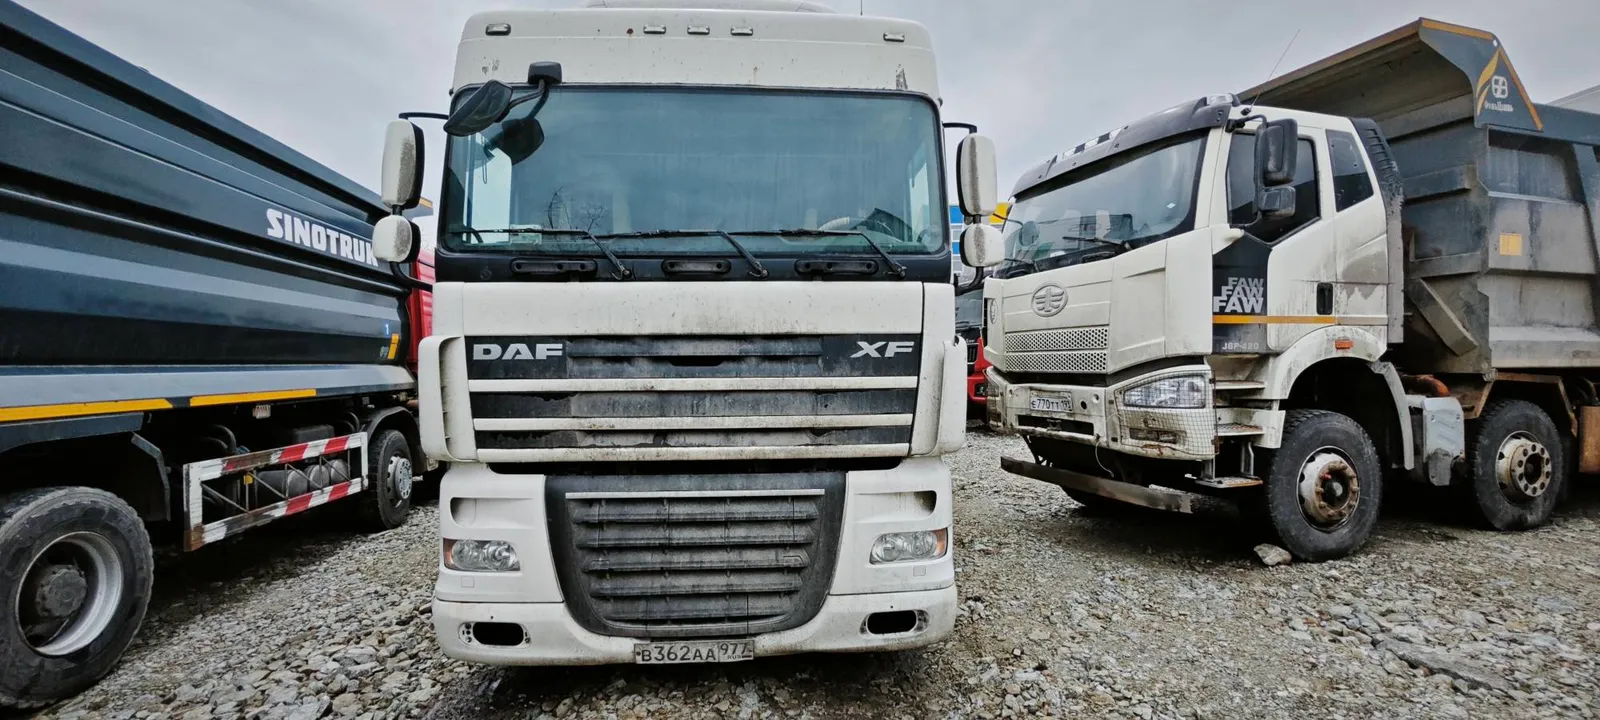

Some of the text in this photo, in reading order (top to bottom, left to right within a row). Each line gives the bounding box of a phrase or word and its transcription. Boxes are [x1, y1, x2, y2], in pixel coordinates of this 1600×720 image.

[266, 208, 379, 267] SINOTRUK
[1228, 277, 1264, 288] FAW
[1221, 286, 1264, 298] FAW
[1213, 296, 1264, 313] FAW
[473, 343, 563, 360] DAF
[850, 341, 915, 358] XF
[720, 643, 748, 655] 977
